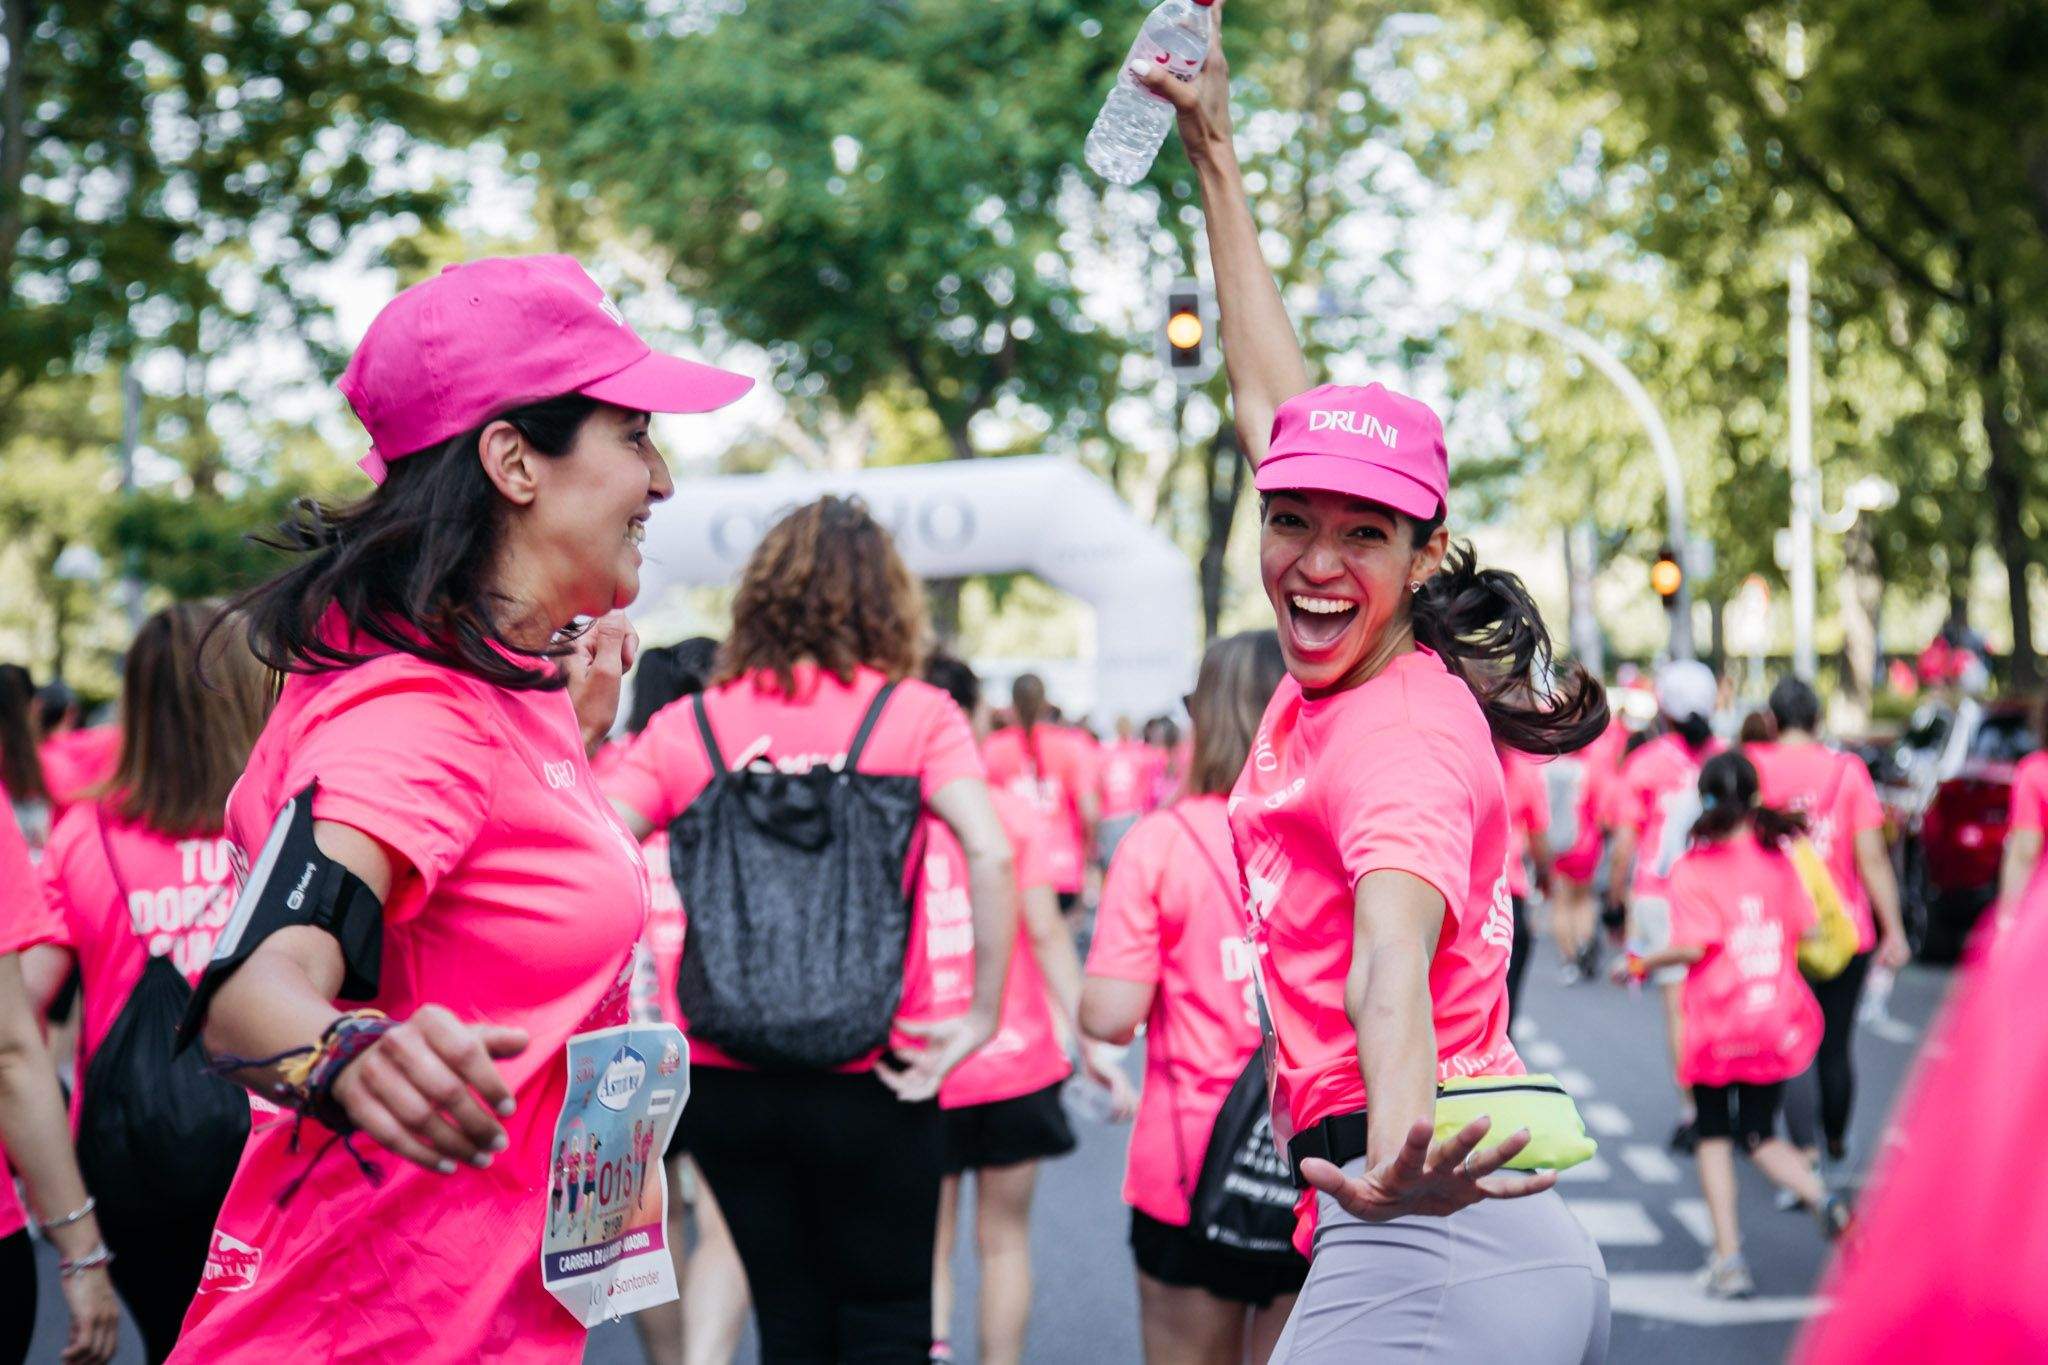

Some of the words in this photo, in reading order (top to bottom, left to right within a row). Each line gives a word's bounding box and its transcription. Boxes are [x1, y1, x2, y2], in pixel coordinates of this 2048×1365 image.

[1309, 410, 1398, 449] DRUNI
[178, 839, 230, 883] TU
[130, 884, 231, 935] DORS
[559, 1252, 594, 1273] CARRERA
[622, 1232, 650, 1252] MADRID
[612, 1270, 659, 1296] Santander
